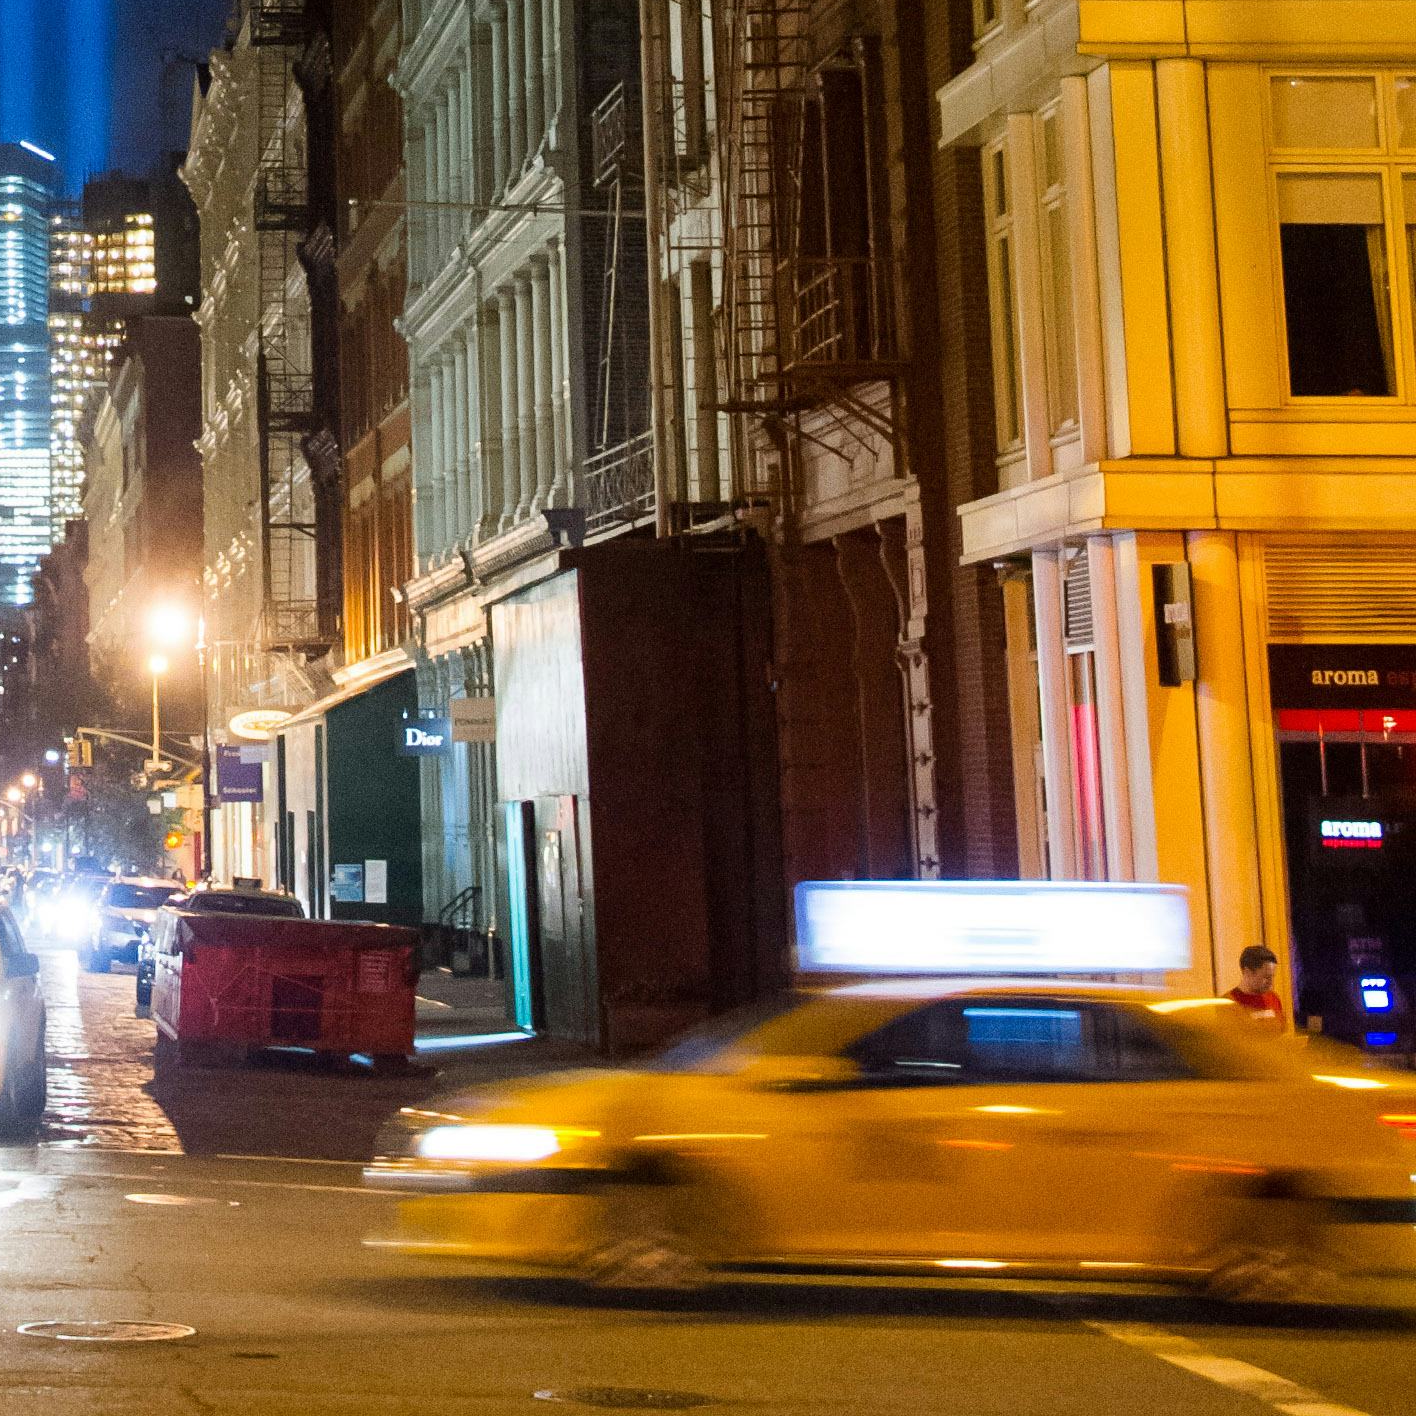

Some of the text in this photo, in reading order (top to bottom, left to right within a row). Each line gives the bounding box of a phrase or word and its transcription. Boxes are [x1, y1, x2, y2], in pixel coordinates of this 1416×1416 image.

[1311, 670, 1379, 685] aroma
[406, 728, 444, 746] Dior
[1321, 820, 1382, 838] aroma
